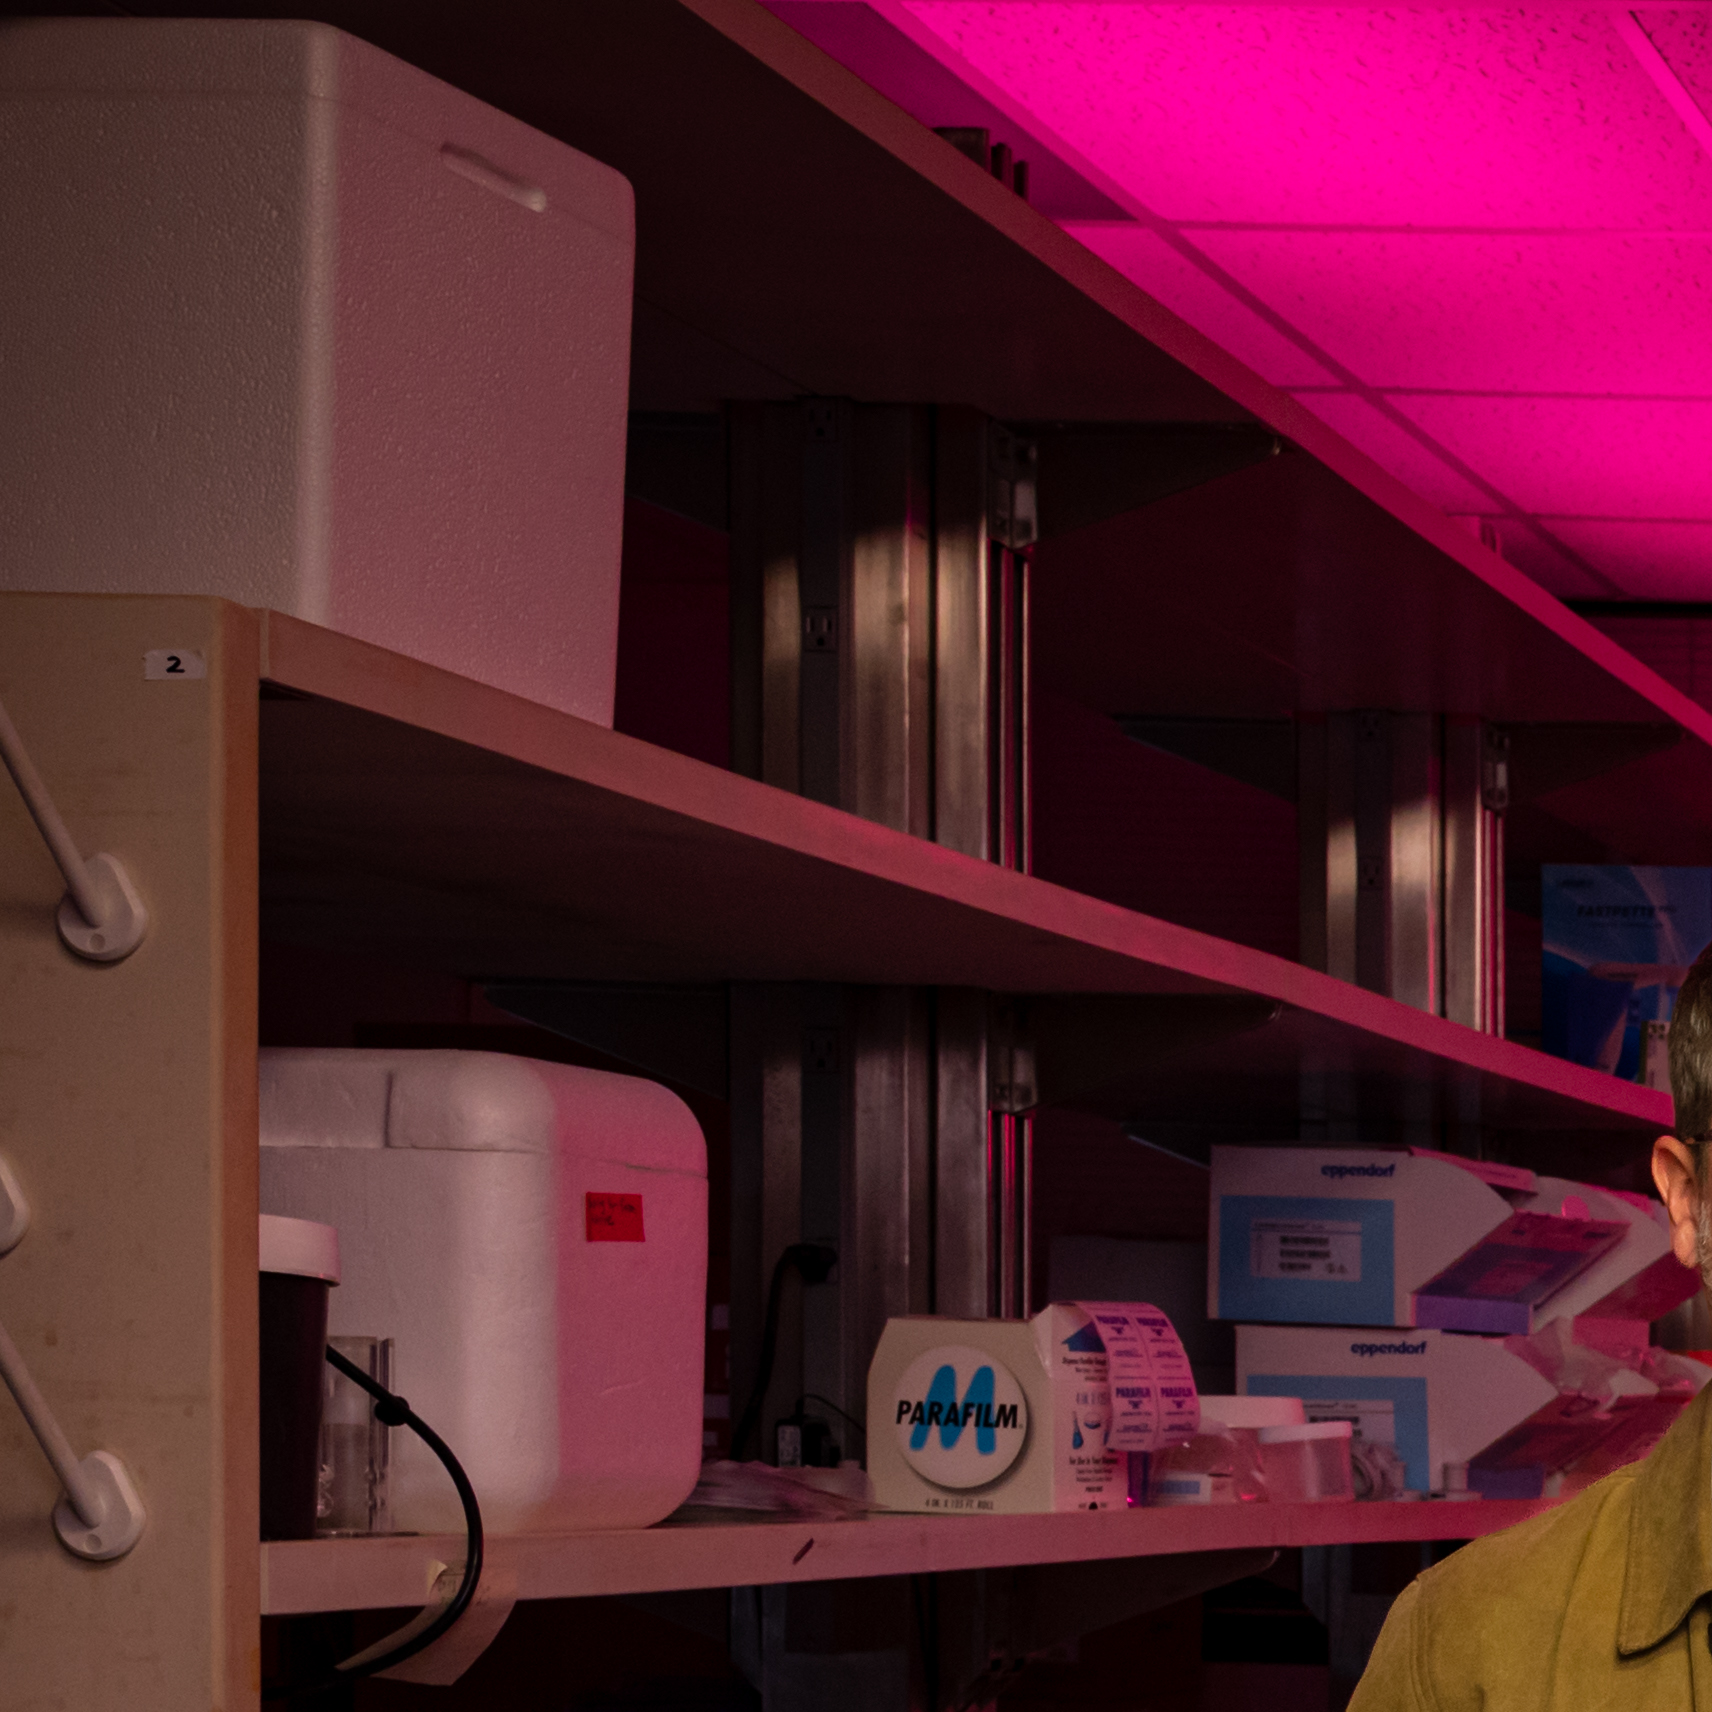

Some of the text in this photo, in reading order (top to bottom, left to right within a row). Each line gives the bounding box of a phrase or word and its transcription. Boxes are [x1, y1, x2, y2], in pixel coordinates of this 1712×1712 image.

[165, 655, 185, 673] 2
[1321, 1163, 1396, 1178] eppendorf
[1350, 1340, 1427, 1357] eppendorf
[896, 1400, 1019, 1429] PARAFILM
